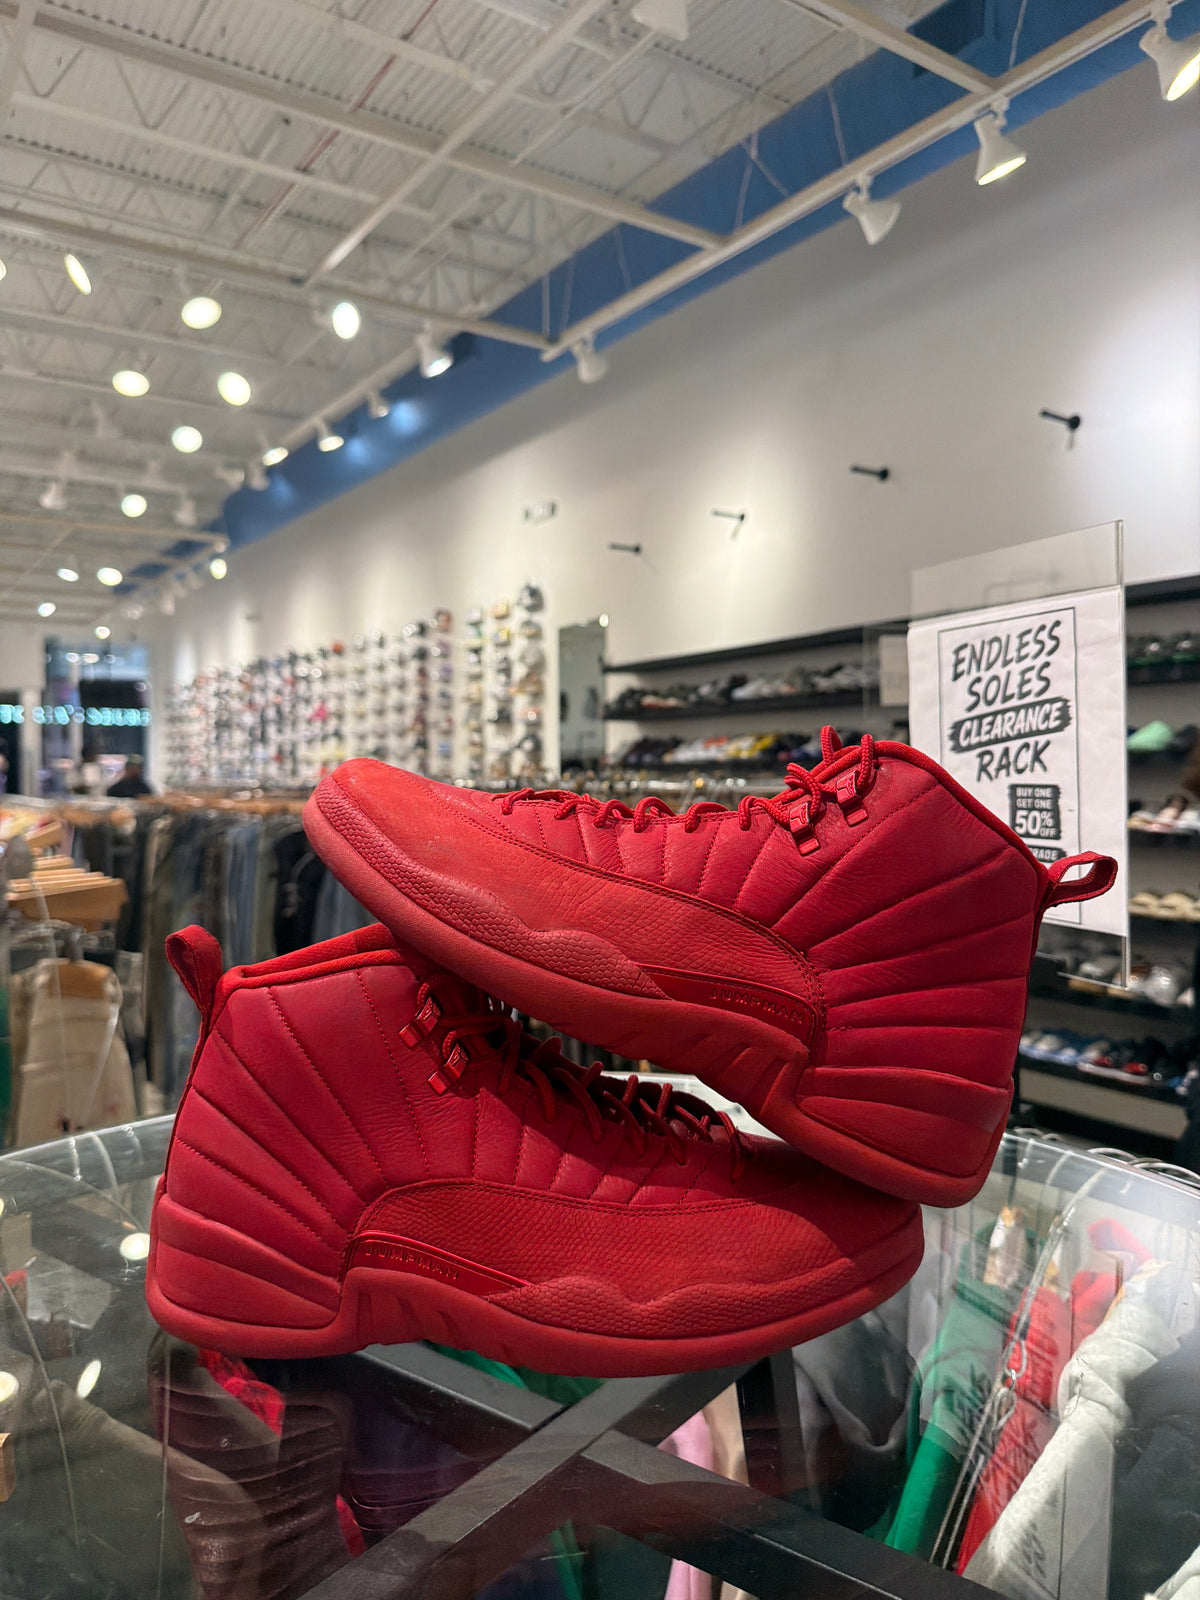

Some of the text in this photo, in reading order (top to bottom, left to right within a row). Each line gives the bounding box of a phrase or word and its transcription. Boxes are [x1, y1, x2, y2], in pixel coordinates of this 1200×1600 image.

[952, 620, 1062, 682] ENDLESS
[965, 661, 1051, 713] SOLES
[958, 701, 1064, 748] CLEARANCE
[976, 739, 1052, 783] RACK
[1016, 787, 1053, 798] BUY ONE
[1016, 798, 1053, 810] GET ONE
[1014, 810, 1057, 837] 50% OFF
